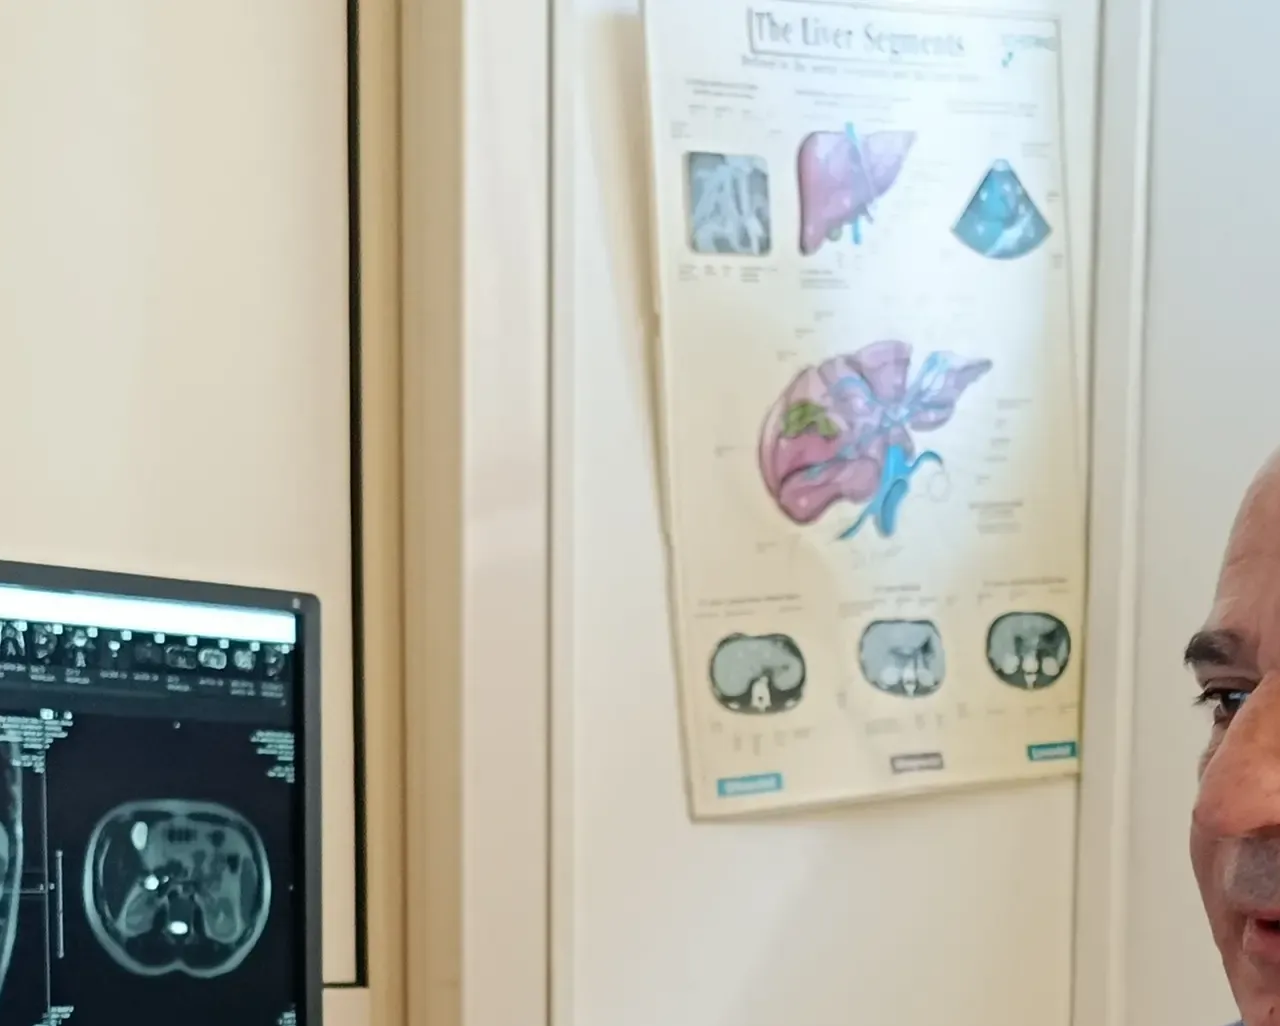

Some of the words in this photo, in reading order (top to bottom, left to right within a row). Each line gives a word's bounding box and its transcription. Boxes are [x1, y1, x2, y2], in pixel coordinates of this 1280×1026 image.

[754, 12, 793, 44] The
[800, 17, 854, 50] Liver
[863, 22, 966, 62] Segments
